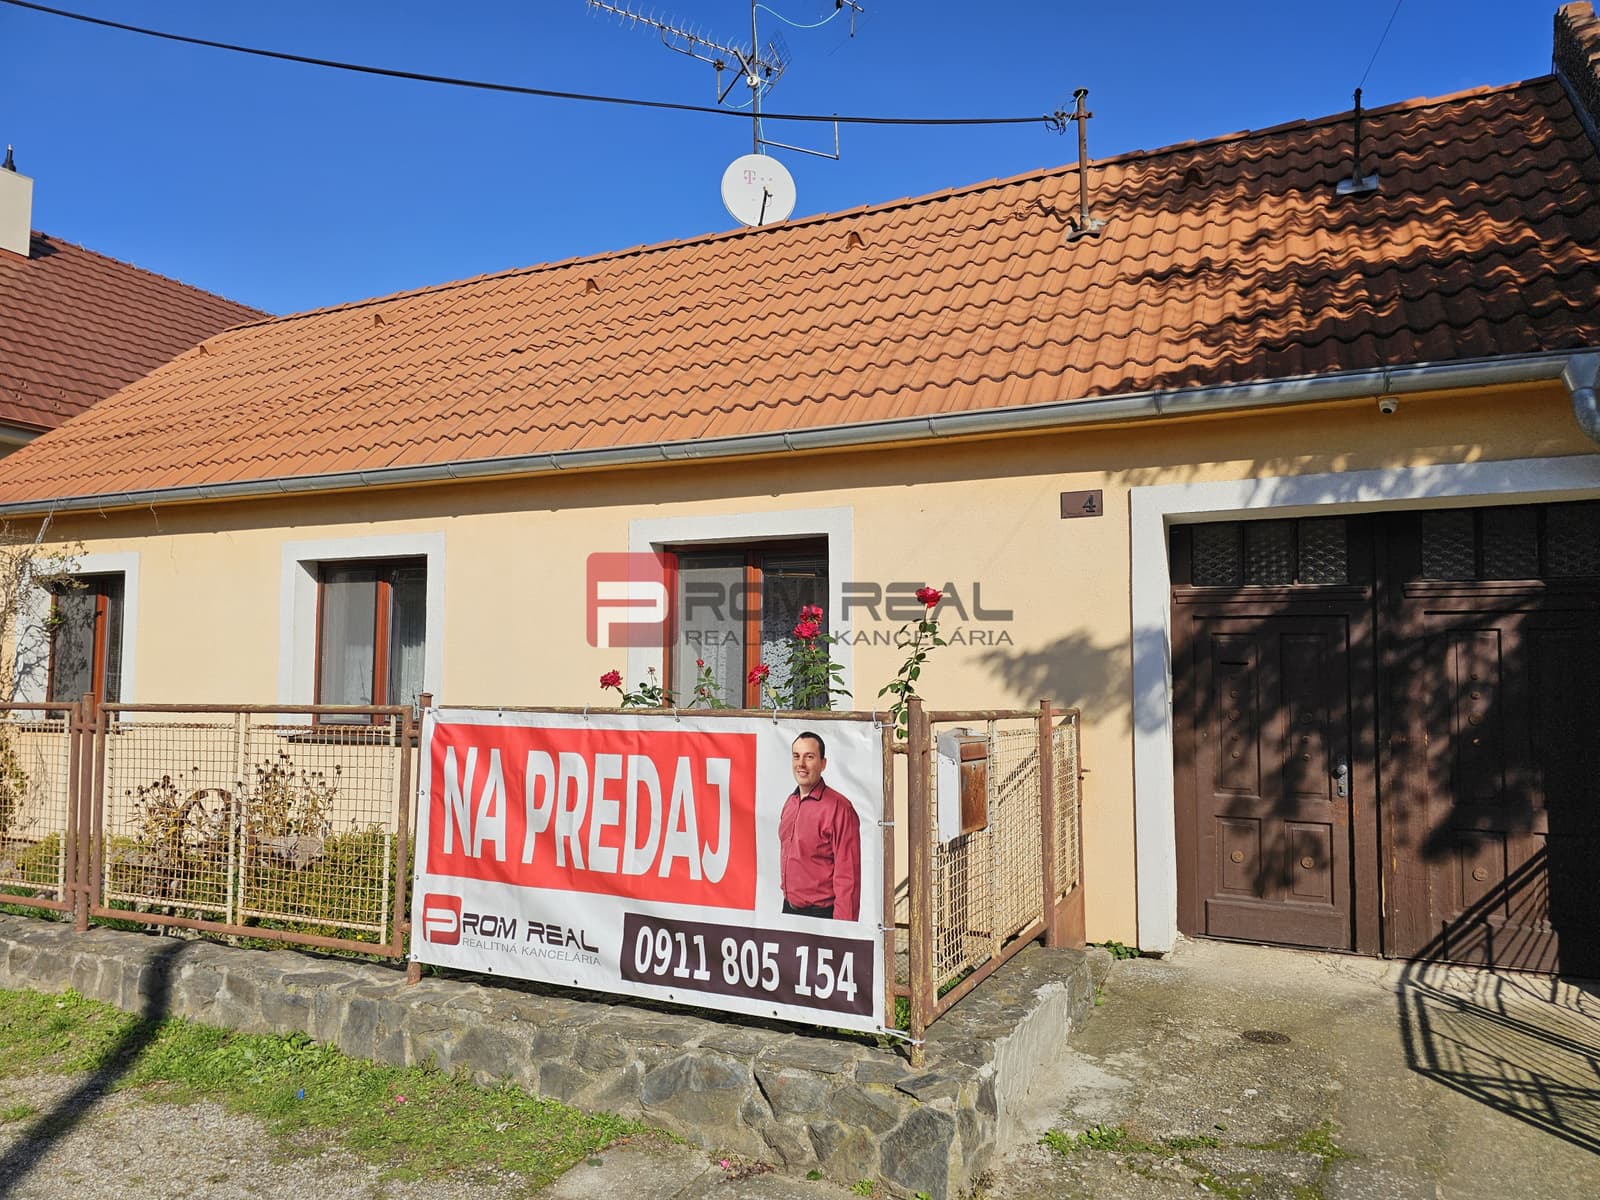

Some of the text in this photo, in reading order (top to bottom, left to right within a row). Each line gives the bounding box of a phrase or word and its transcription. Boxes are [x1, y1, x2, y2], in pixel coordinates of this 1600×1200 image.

[1082, 494, 1097, 513] 4
[443, 746, 731, 883] NA PREDAJ
[462, 937, 601, 965] REALITNÁ KANCELÁRIA
[526, 920, 599, 953] REAL
[634, 926, 857, 1001] 0911 805 154
